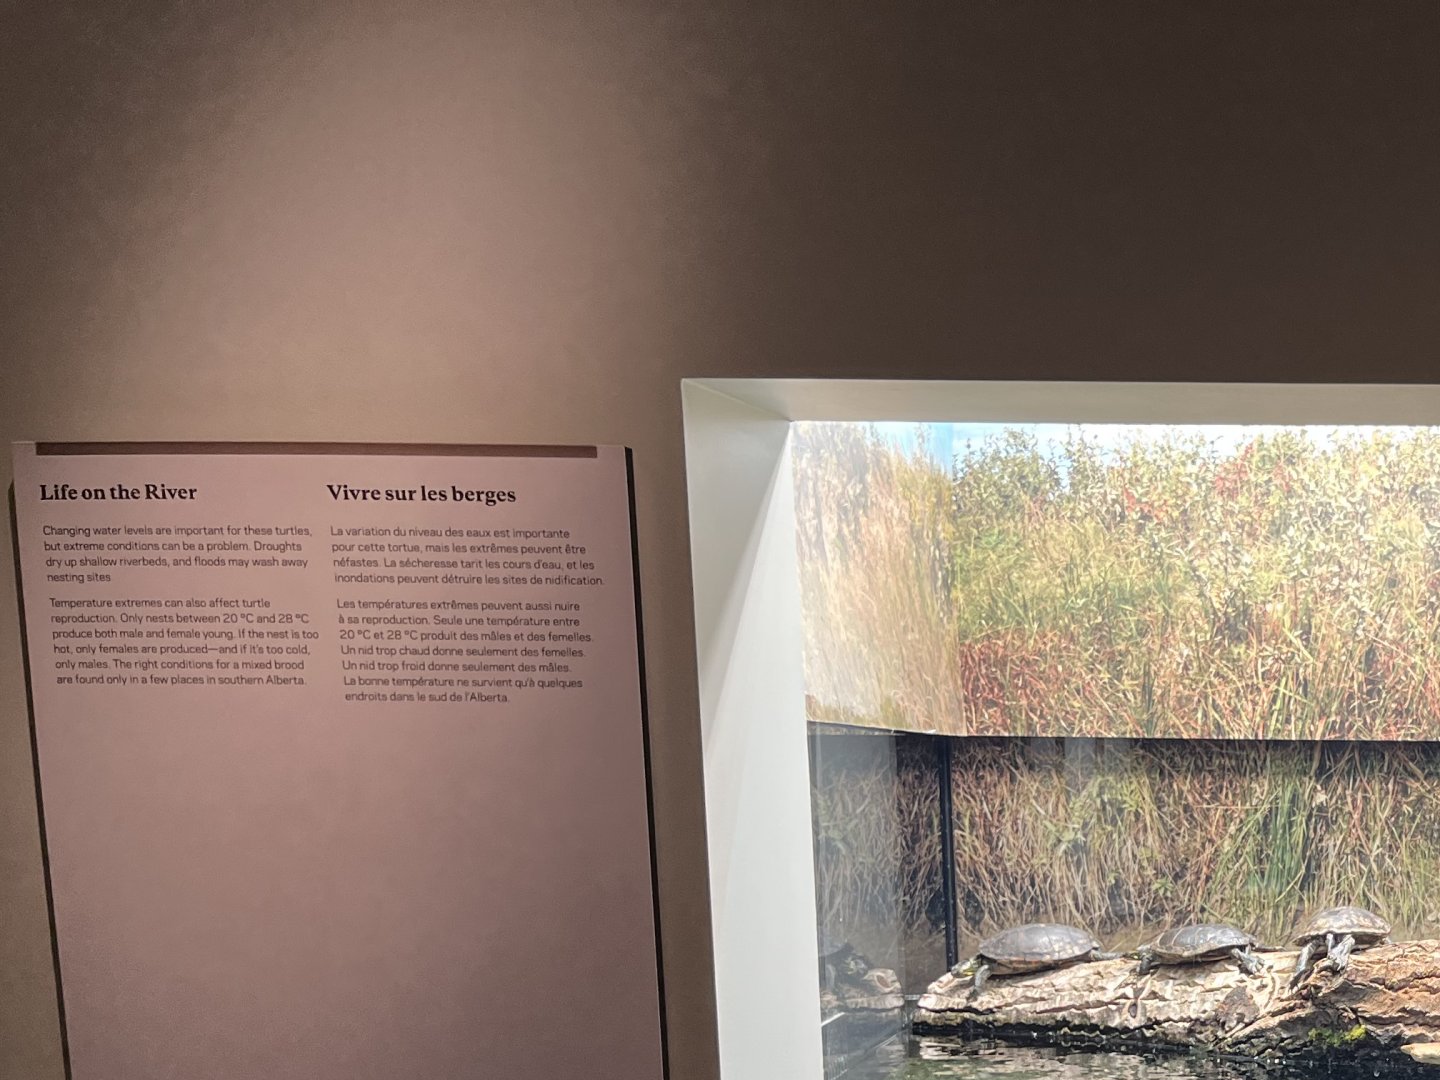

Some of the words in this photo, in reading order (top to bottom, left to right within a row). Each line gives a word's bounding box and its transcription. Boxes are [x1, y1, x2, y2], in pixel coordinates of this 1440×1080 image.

[40, 483, 78, 500] Life
[81, 488, 106, 500] on
[109, 483, 140, 500] the
[144, 483, 198, 500] River
[327, 484, 381, 500] Vivre
[385, 489, 417, 501] sur
[421, 484, 447, 501] les
[451, 485, 517, 505] berges
[43, 523, 91, 538] Changing
[92, 524, 121, 535] water
[124, 524, 153, 535] levels
[155, 526, 172, 535] are
[174, 524, 224, 538] important
[227, 524, 241, 535] for
[243, 524, 273, 535] these
[275, 524, 313, 537] turtles,
[330, 525, 343, 536] La
[345, 525, 391, 536] variation
[393, 525, 406, 536] du
[408, 525, 442, 537] niveau
[444, 526, 464, 537] des
[466, 529, 491, 537] eaux
[493, 526, 510, 537] est
[512, 526, 571, 541] importante
[44, 539, 61, 550] but
[63, 539, 104, 550] extreme
[107, 539, 160, 550] conditions
[161, 542, 180, 550] can
[182, 539, 195, 550] be
[198, 542, 204, 551] a
[253, 539, 303, 553] Droughts
[332, 543, 355, 554] pour
[357, 540, 385, 552] cette
[387, 541, 423, 554] tortue,
[425, 541, 450, 552] mais
[452, 541, 467, 552] les
[469, 541, 519, 553] extrêmes
[520, 542, 562, 556] peuvent
[564, 542, 587, 553] être
[46, 555, 62, 569] dry
[64, 557, 77, 569] up
[79, 555, 117, 566] shallow
[119, 555, 170, 568] riverbeds,
[172, 555, 192, 566] and
[194, 555, 226, 566] floods
[228, 558, 249, 569] may
[251, 555, 279, 566] wash
[281, 558, 309, 569] away
[47, 570, 85, 584] nesting
[86, 570, 112, 581] sites
[335, 571, 395, 583] inondations
[397, 572, 439, 586] peuvent
[441, 572, 482, 584] détruire
[484, 573, 500, 584] les
[502, 573, 527, 584] sites
[529, 573, 543, 584] de
[49, 596, 113, 610] Temperature
[115, 596, 162, 608] extremes
[164, 599, 183, 608] can
[185, 596, 206, 608] also
[209, 597, 240, 608] affect
[242, 597, 271, 608] turtle
[337, 597, 355, 608] Les
[357, 598, 428, 612] températures
[430, 598, 479, 609] extrêmes
[481, 599, 523, 613] peuvent
[525, 599, 552, 610] aussi
[554, 599, 581, 610] nuire
[120, 612, 143, 626] Only
[145, 612, 174, 623] nests
[175, 612, 220, 623] between
[222, 612, 238, 623] 20
[256, 612, 276, 623] and
[278, 612, 293, 623] 28
[339, 613, 345, 624] à
[347, 616, 359, 624] sa
[433, 614, 462, 625] Seule
[464, 617, 484, 625] une
[486, 614, 550, 628] température
[552, 615, 581, 626] entre
[341, 644, 356, 655] Un
[358, 644, 374, 655] nid
[375, 644, 397, 658] trop
[398, 644, 430, 655] chaud
[432, 644, 463, 656] donne
[465, 645, 518, 656] seulement
[520, 645, 539, 656] des
[55, 657, 76, 672] only
[112, 658, 132, 669] The
[134, 658, 158, 672] right
[160, 658, 214, 669] conditions
[216, 658, 230, 669] for
[233, 661, 239, 669] a
[241, 658, 272, 669] mixed
[274, 658, 305, 669] brood
[57, 675, 73, 684] are
[75, 673, 104, 684] found
[106, 673, 127, 687] only
[129, 673, 139, 684] in
[141, 676, 148, 684] a
[149, 673, 168, 684] few
[170, 673, 204, 687] places
[206, 673, 216, 684] in
[218, 673, 264, 684] southern
[345, 689, 387, 701] endroits
[389, 690, 415, 701] dans
[417, 690, 426, 701] le
[428, 690, 447, 701] sud
[449, 690, 462, 702] de
